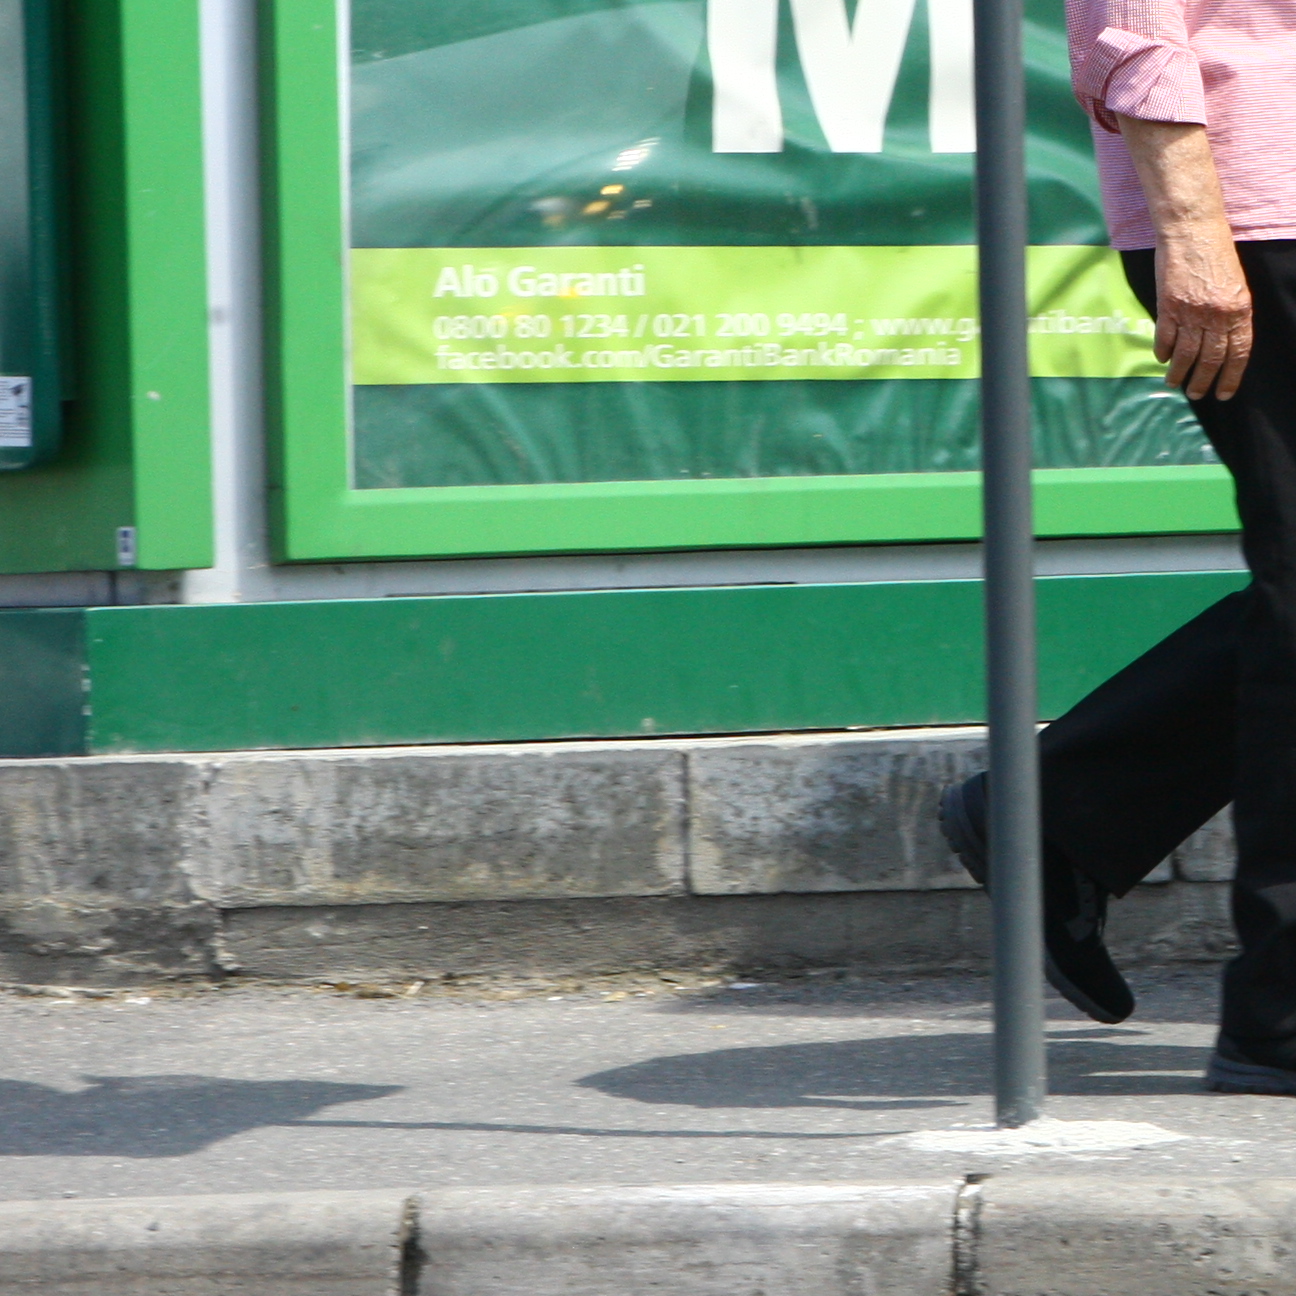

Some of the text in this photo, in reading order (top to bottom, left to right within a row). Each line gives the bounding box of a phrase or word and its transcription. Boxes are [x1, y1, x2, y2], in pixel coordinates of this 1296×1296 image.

[509, 264, 645, 297] Garanti
[434, 315, 507, 339] 0800
[514, 314, 551, 339] 80
[560, 314, 630, 338] 1234
[652, 313, 707, 338] 021
[715, 313, 770, 337] 200
[775, 313, 847, 337] 9494
